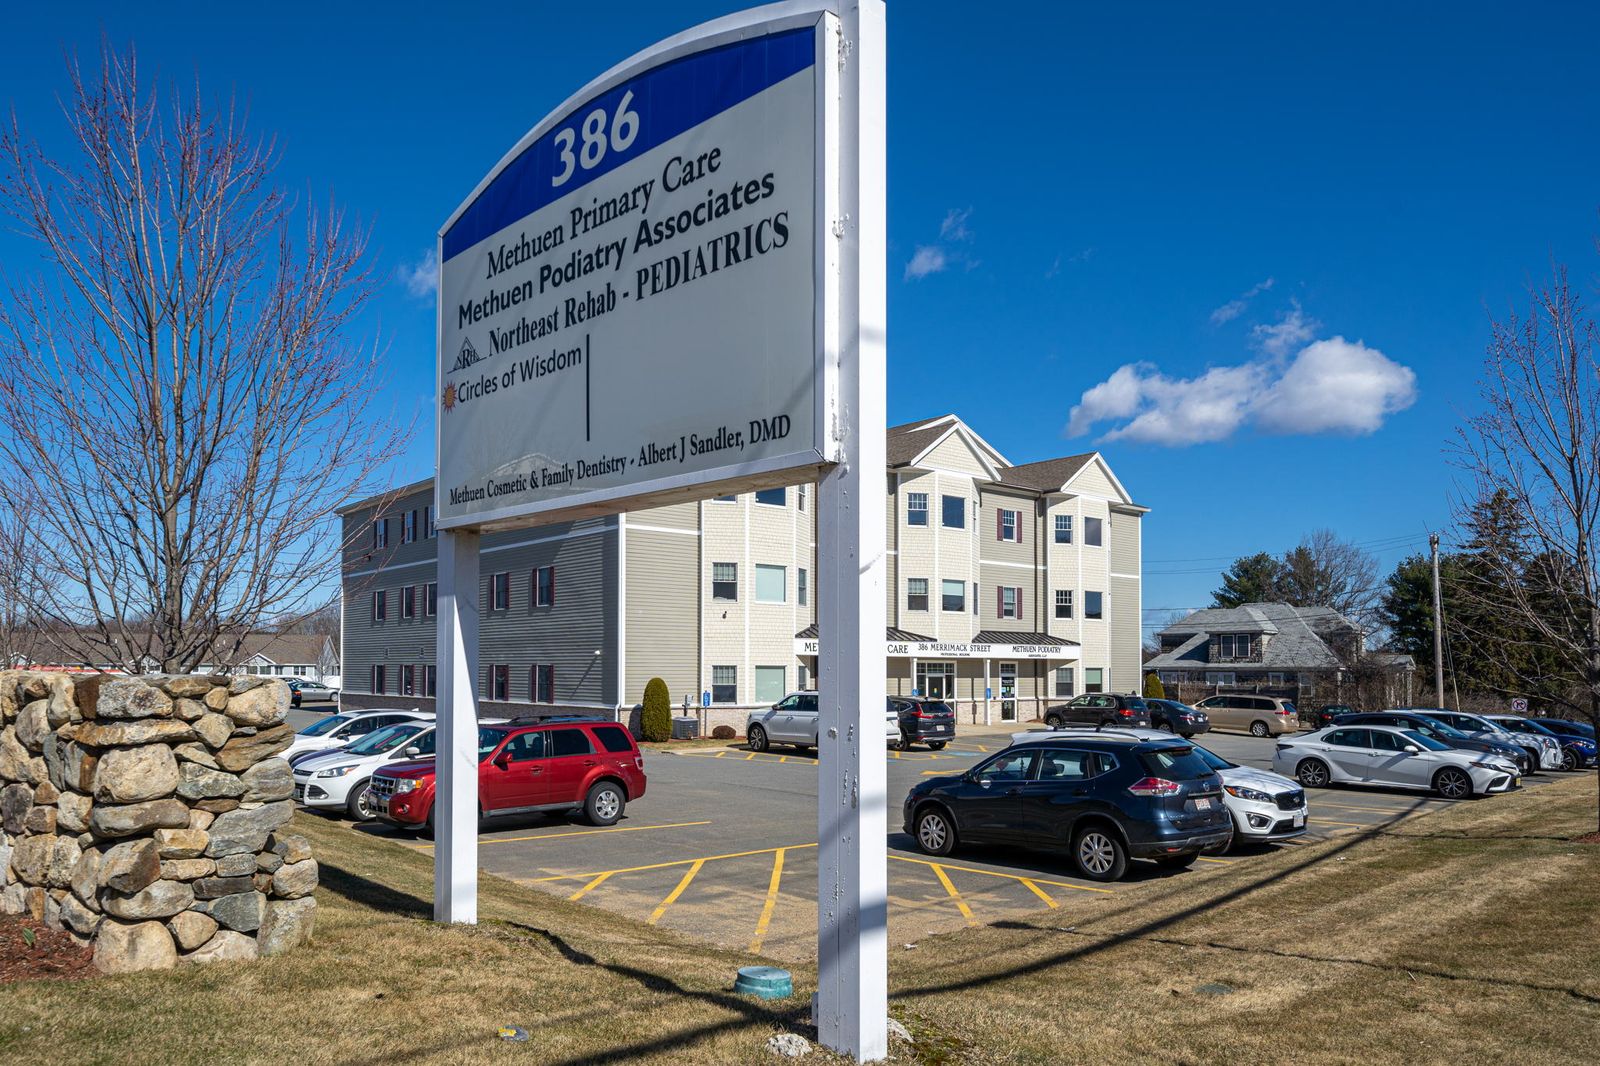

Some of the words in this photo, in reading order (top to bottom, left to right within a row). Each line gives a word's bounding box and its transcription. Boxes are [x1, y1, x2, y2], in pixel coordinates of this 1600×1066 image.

[552, 89, 640, 187] 386
[458, 277, 533, 329] Methuen
[539, 235, 628, 294] Podiatry
[632, 172, 775, 254] Associates
[486, 220, 565, 280] Methuen
[570, 177, 655, 241] Primary
[662, 146, 722, 193] Care
[488, 304, 559, 358] Northeast
[564, 282, 616, 329] Rehab
[636, 210, 790, 302] PEDIATRICS
[458, 375, 498, 403] Circles
[502, 362, 516, 389] of
[520, 346, 582, 382] Wisdom
[449, 481, 485, 506] Methuen
[486, 472, 527, 497] Cosmetic
[529, 470, 539, 489] &
[541, 463, 574, 488] Family
[576, 453, 627, 482] Dentistry
[638, 440, 677, 468] Albert
[679, 436, 686, 463] J
[689, 425, 745, 457] Sandler,
[749, 413, 791, 445] DMD
[805, 642, 818, 652] ME
[887, 644, 909, 653] CARE
[918, 643, 928, 651] 386
[930, 643, 968, 651] MERRIMACK
[970, 644, 991, 652] STREET
[1012, 645, 1037, 653] METHUEN
